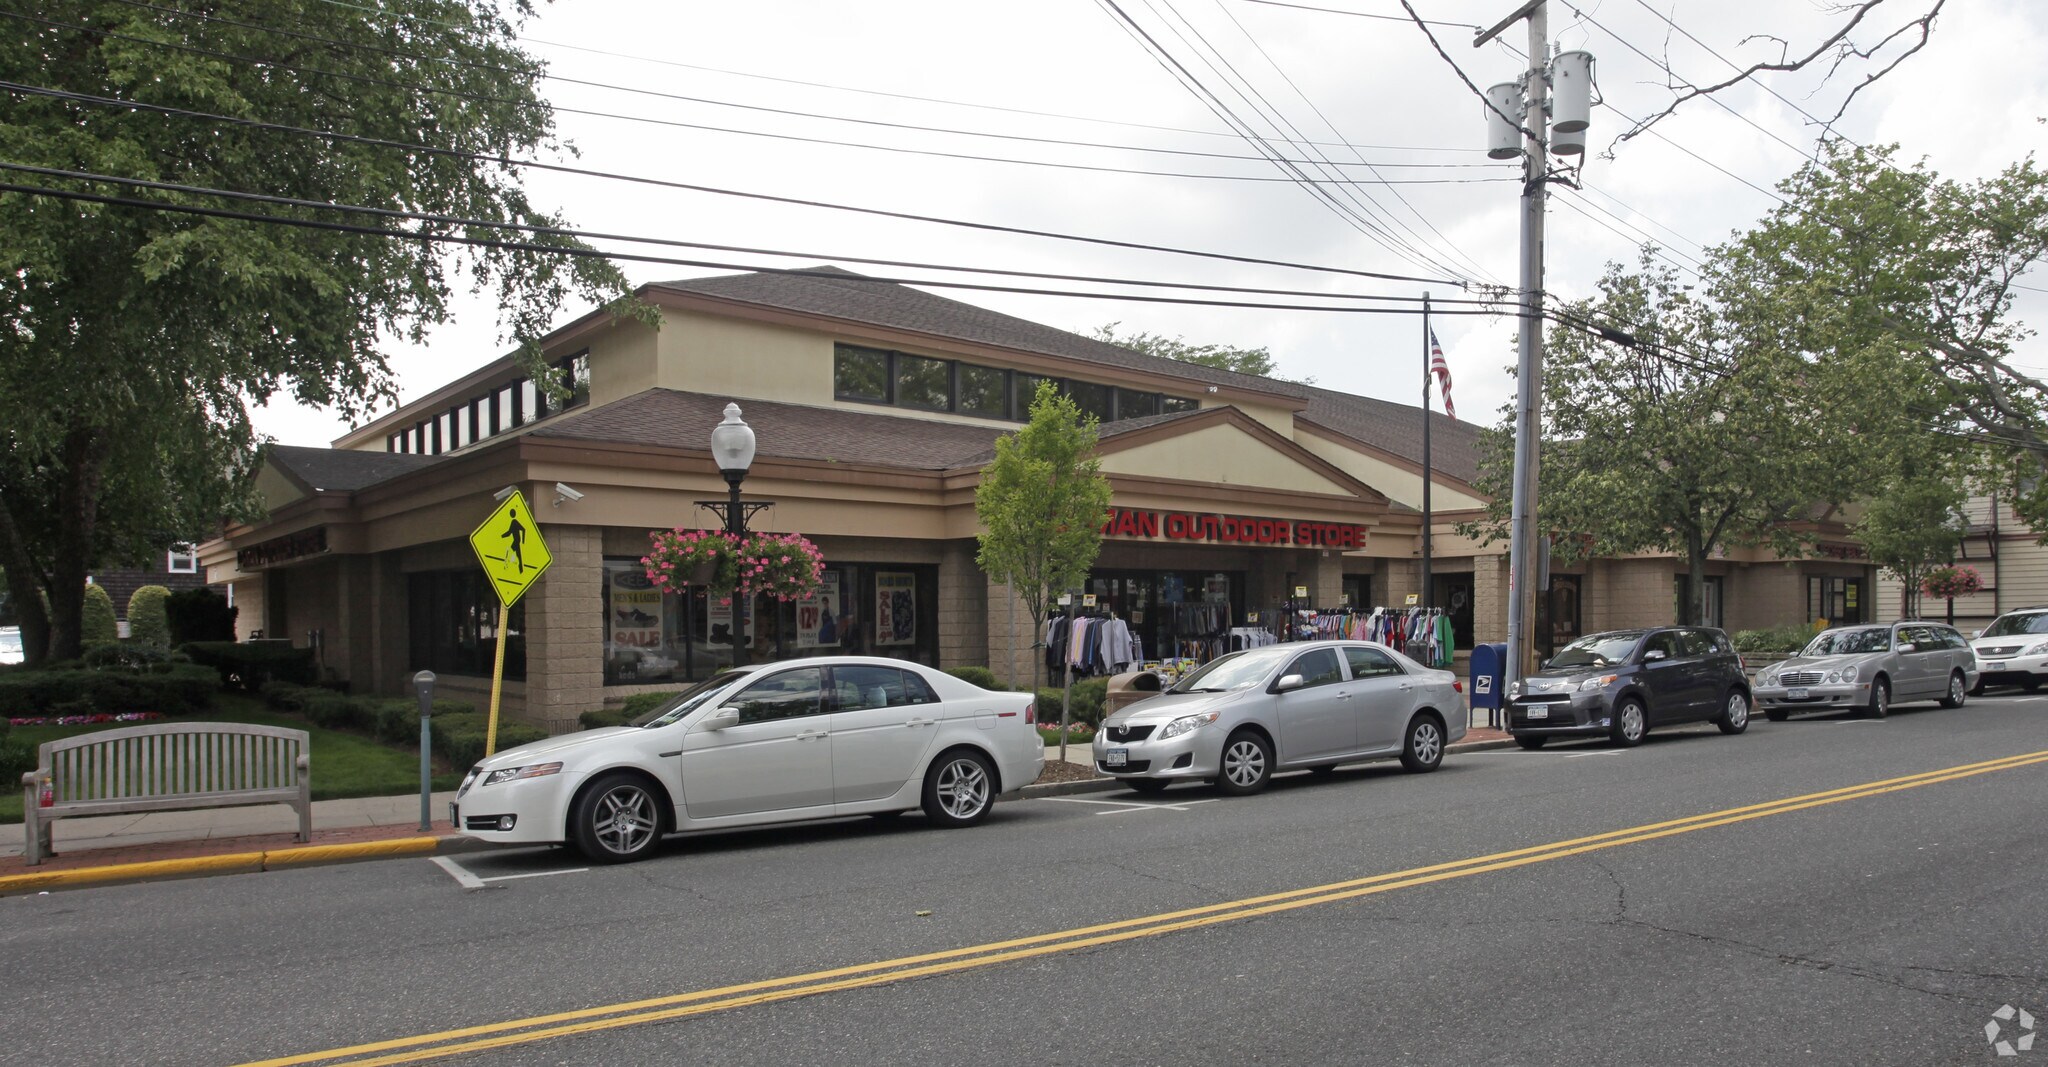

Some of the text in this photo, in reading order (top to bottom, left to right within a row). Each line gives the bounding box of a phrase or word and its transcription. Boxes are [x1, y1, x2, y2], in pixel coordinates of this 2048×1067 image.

[1165, 514, 1290, 544] OUTDOOR
[1295, 522, 1366, 548] STORE
[614, 631, 661, 647] SALE
